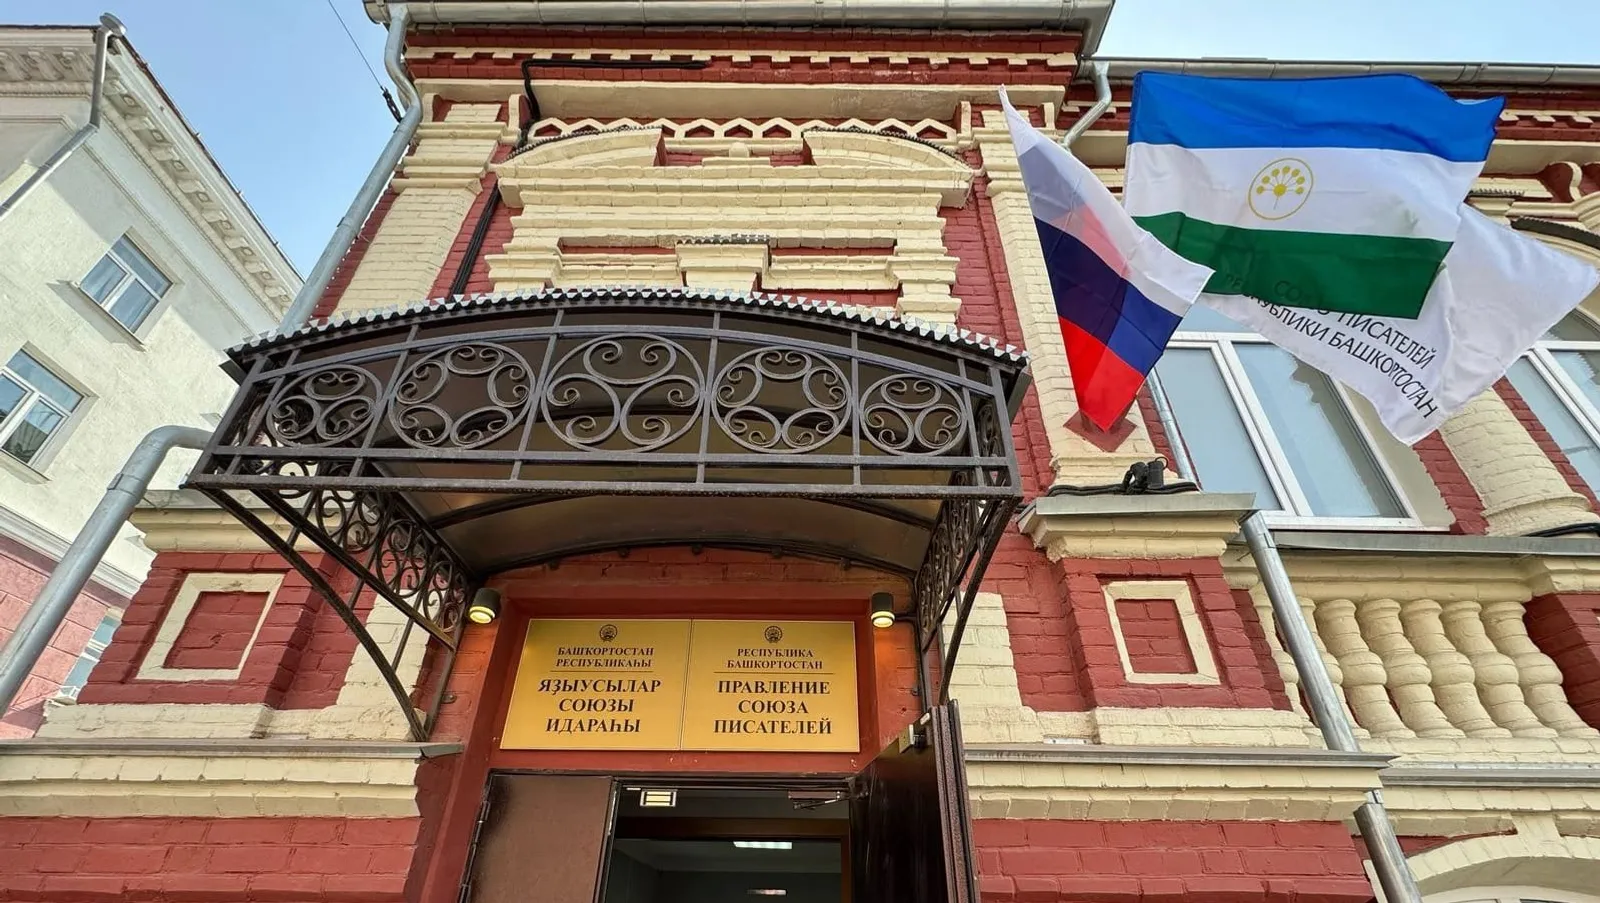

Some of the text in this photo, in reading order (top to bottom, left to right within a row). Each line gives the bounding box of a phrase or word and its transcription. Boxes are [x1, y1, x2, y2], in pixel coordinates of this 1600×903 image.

[1337, 311, 1437, 370] ПИСАТЕЛЕЙ
[1328, 331, 1438, 419] БАШКОРТОСТАН
[737, 648, 814, 658] РЕСПУБЛИКА
[727, 660, 823, 670] БАШКОРТОСТАН
[718, 680, 831, 695] ПРАВЛЕНИЕ
[558, 698, 634, 713] СОЮЗЫ
[738, 700, 809, 714] СОЮЗА
[713, 717, 832, 735] ПИСАТЕЛЕЙ
